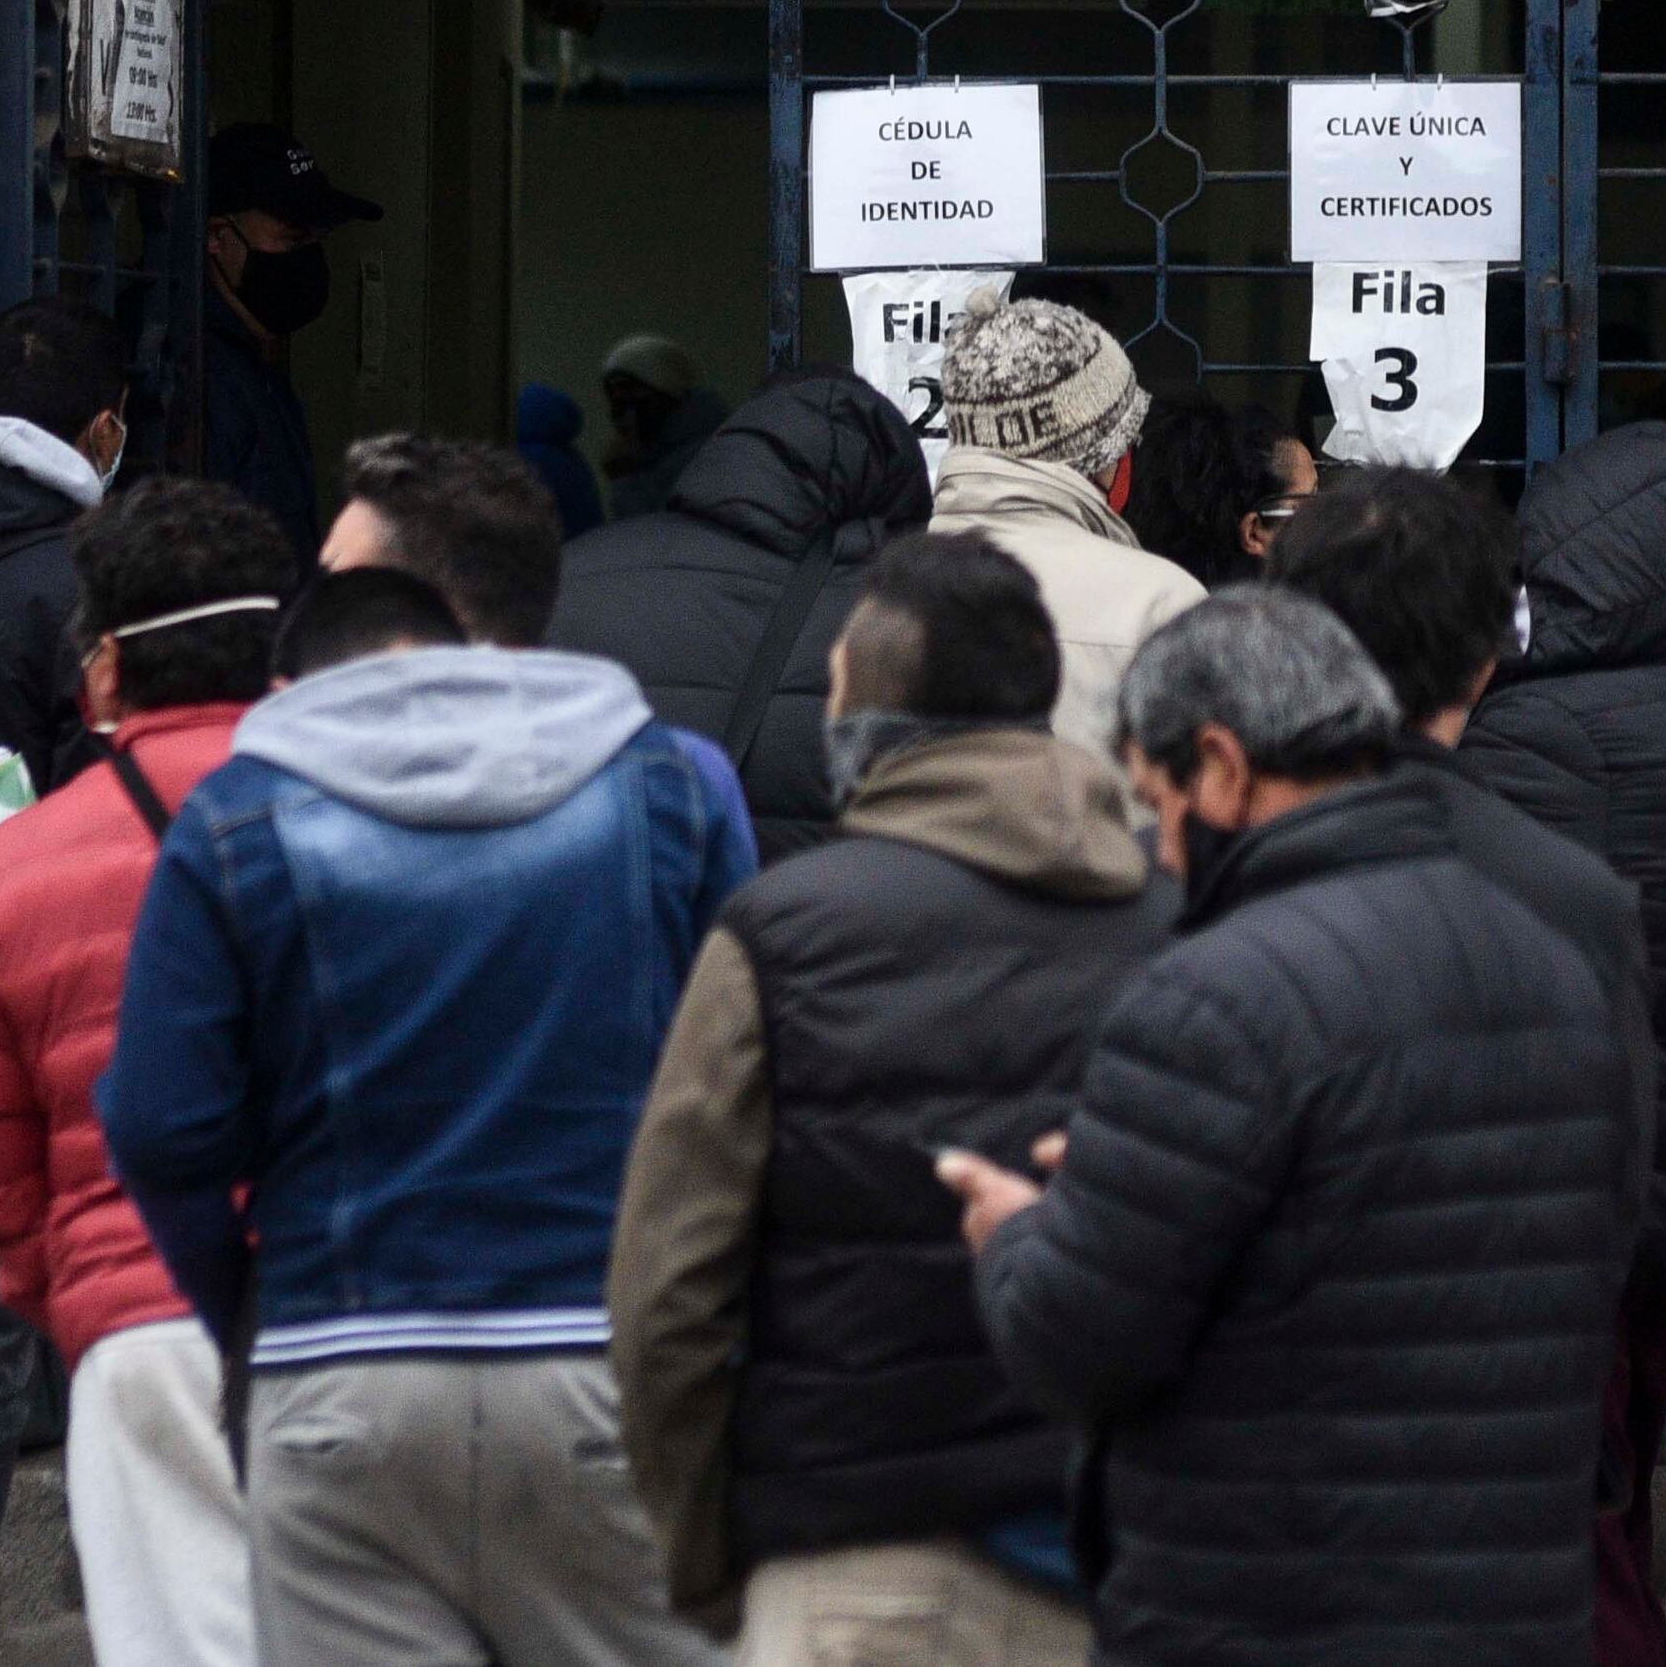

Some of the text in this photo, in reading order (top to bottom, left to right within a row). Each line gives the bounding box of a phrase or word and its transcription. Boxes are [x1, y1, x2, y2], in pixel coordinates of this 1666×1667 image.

[879, 115, 972, 141] CÉDULA
[1327, 111, 1485, 136] CLAVE ÚNICA
[912, 161, 940, 180] DE
[1400, 157, 1413, 175] Y
[862, 201, 993, 221] IDENTIDAD
[1321, 197, 1492, 216] CERTIFICADOS
[1353, 271, 1445, 315] Fila
[1371, 347, 1417, 412] 3
[909, 377, 948, 438] 2
